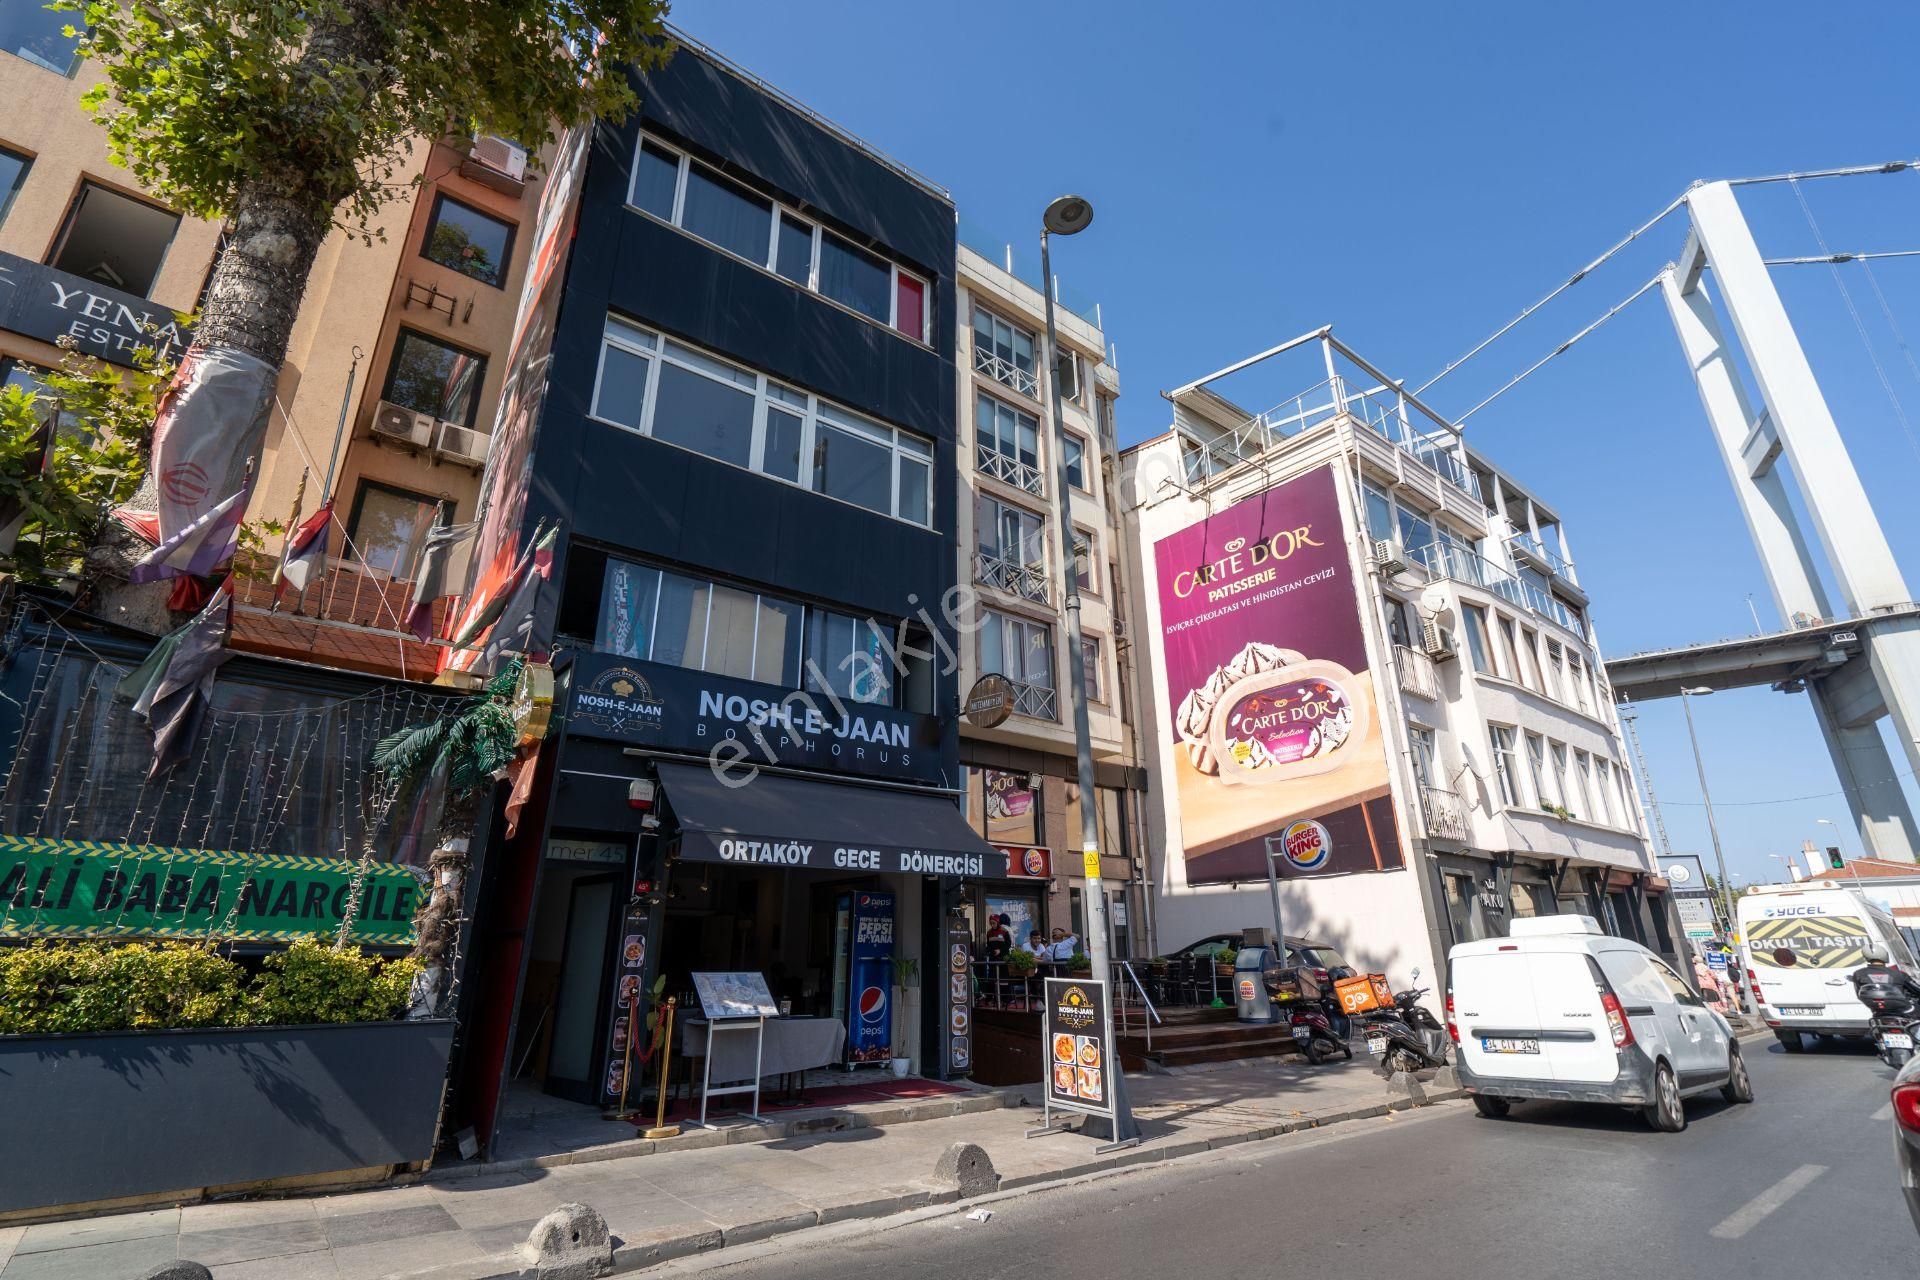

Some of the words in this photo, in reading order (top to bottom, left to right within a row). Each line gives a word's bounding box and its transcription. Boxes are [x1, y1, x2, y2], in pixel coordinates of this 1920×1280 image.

[1173, 552, 1244, 599] CARTE
[1249, 526, 1325, 567] D'OR
[1208, 568, 1277, 603] PATISSERIE
[1166, 618, 1194, 635] İSVİÇRE
[1195, 602, 1240, 626] ÇİKOLATASI
[1240, 597, 1251, 607] VE
[1252, 580, 1302, 603] HİNDİSTAN
[1303, 566, 1336, 586] CEVİZİ
[578, 693, 662, 717] NOSH-E-JAAN
[699, 690, 910, 748] NOSH-E-JAAN
[1241, 711, 1288, 735] CARTE
[1291, 700, 1338, 721] D'OR
[697, 723, 910, 767] BOSPHORUS
[1268, 728, 1305, 741] Selection
[1286, 827, 1319, 848] BURGER
[1289, 835, 1322, 859] KING
[719, 839, 813, 865] ORTAKÖY
[834, 848, 881, 869] GECE
[900, 850, 983, 876] DÖNERCİSİ
[0, 856, 85, 911] ALİ
[98, 869, 222, 916] BABA
[1750, 937, 1800, 950] OKUL
[1344, 992, 1367, 1010] go
[860, 1025, 884, 1037] pepsi
[1487, 1039, 1497, 1049] 34
[1521, 1040, 1537, 1050] 342
